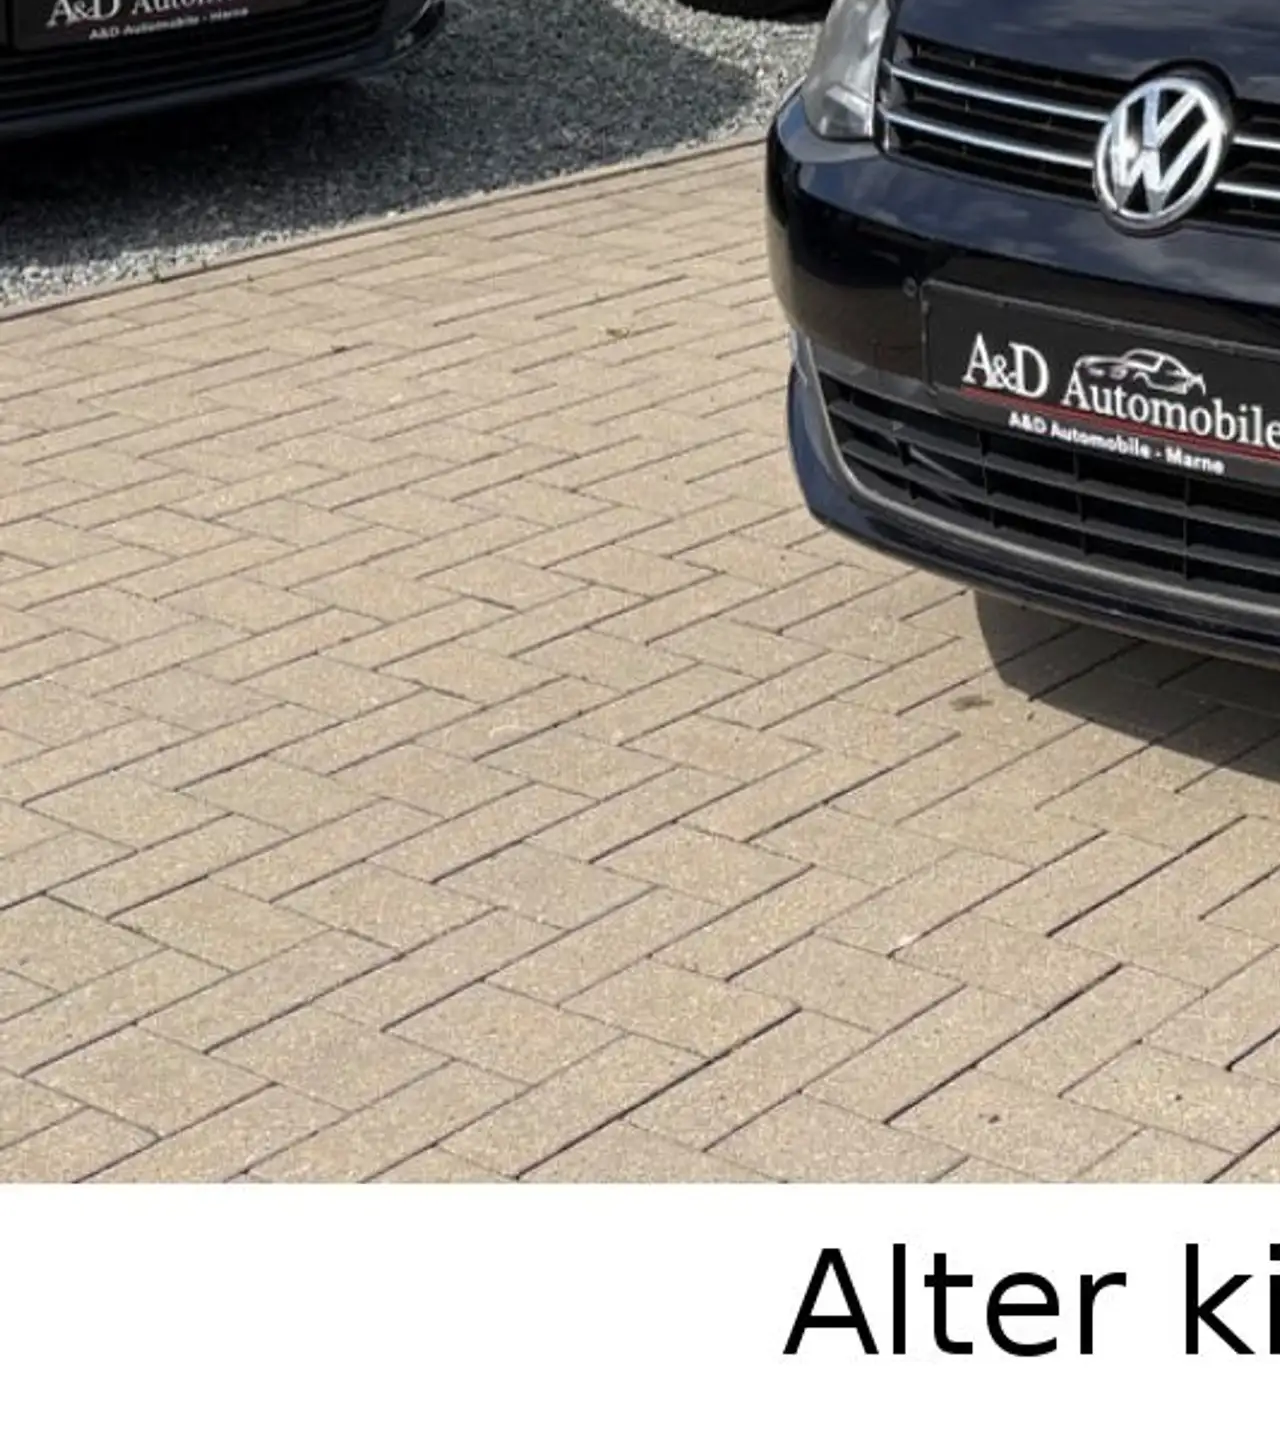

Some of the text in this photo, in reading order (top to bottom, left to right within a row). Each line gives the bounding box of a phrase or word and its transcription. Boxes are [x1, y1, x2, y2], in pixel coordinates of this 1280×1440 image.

[961, 331, 1049, 400] A&D
[1008, 410, 1048, 436] A&D
[1050, 421, 1151, 460] Automobile
[1164, 445, 1226, 475] Marne
